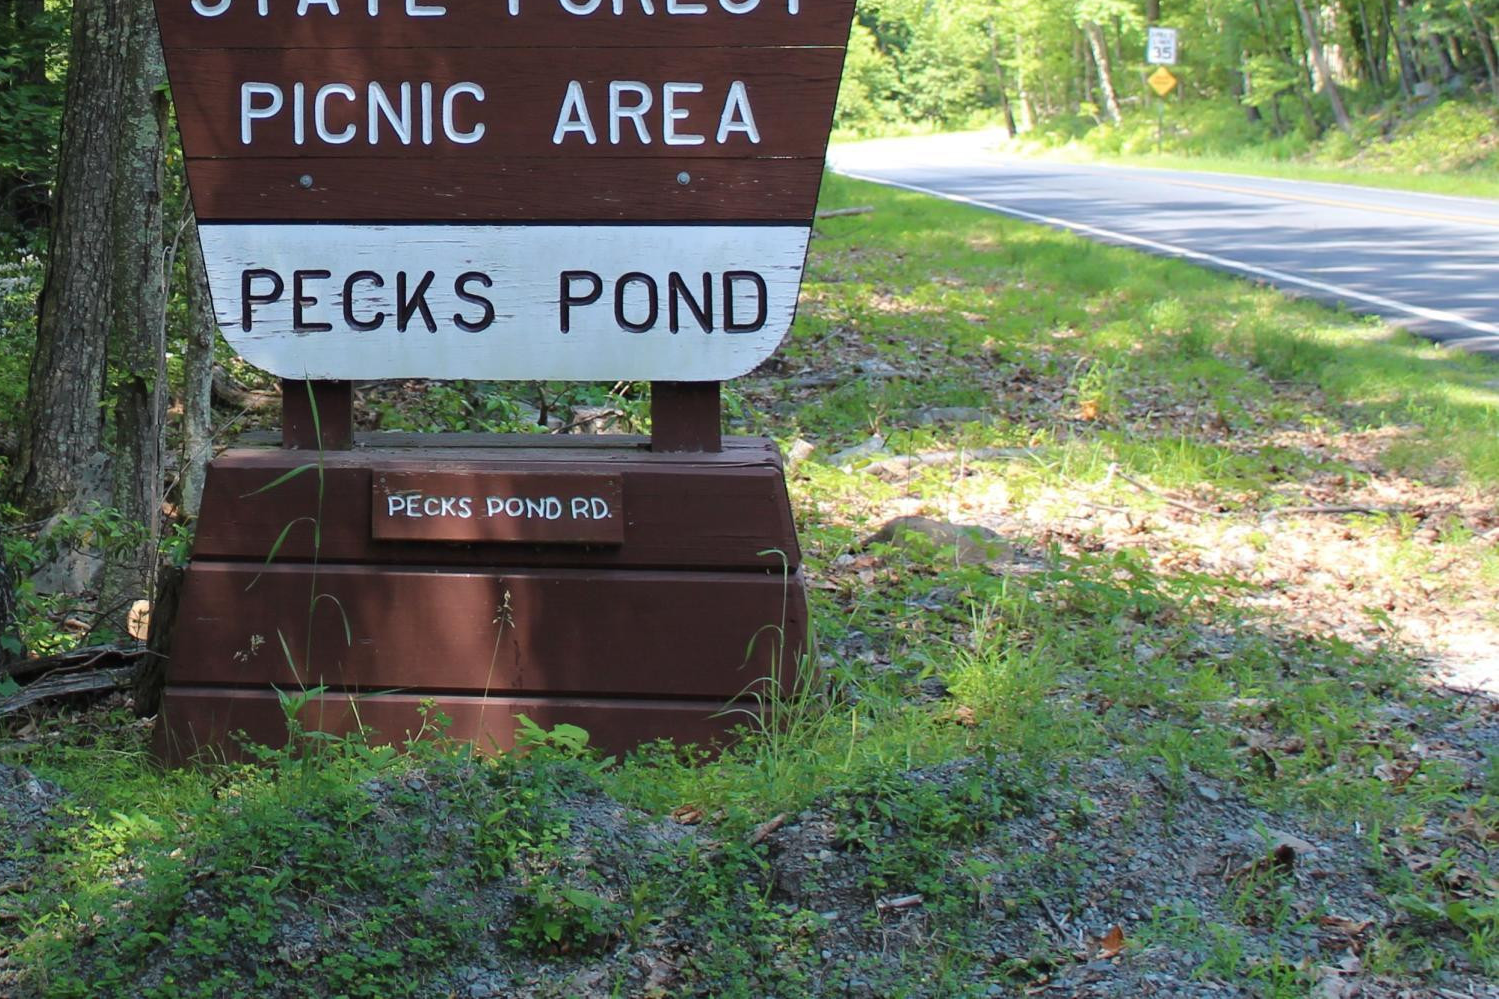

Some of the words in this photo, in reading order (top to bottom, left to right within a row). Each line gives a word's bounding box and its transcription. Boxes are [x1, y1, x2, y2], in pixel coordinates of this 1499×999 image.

[1153, 46, 1172, 59] 35
[240, 80, 486, 145] PICNIC
[552, 80, 761, 145] AREA
[240, 268, 496, 335] PECKS
[559, 270, 769, 335] POND
[387, 495, 473, 518] PECKS
[486, 496, 563, 520] POND
[570, 496, 613, 520] RD.
